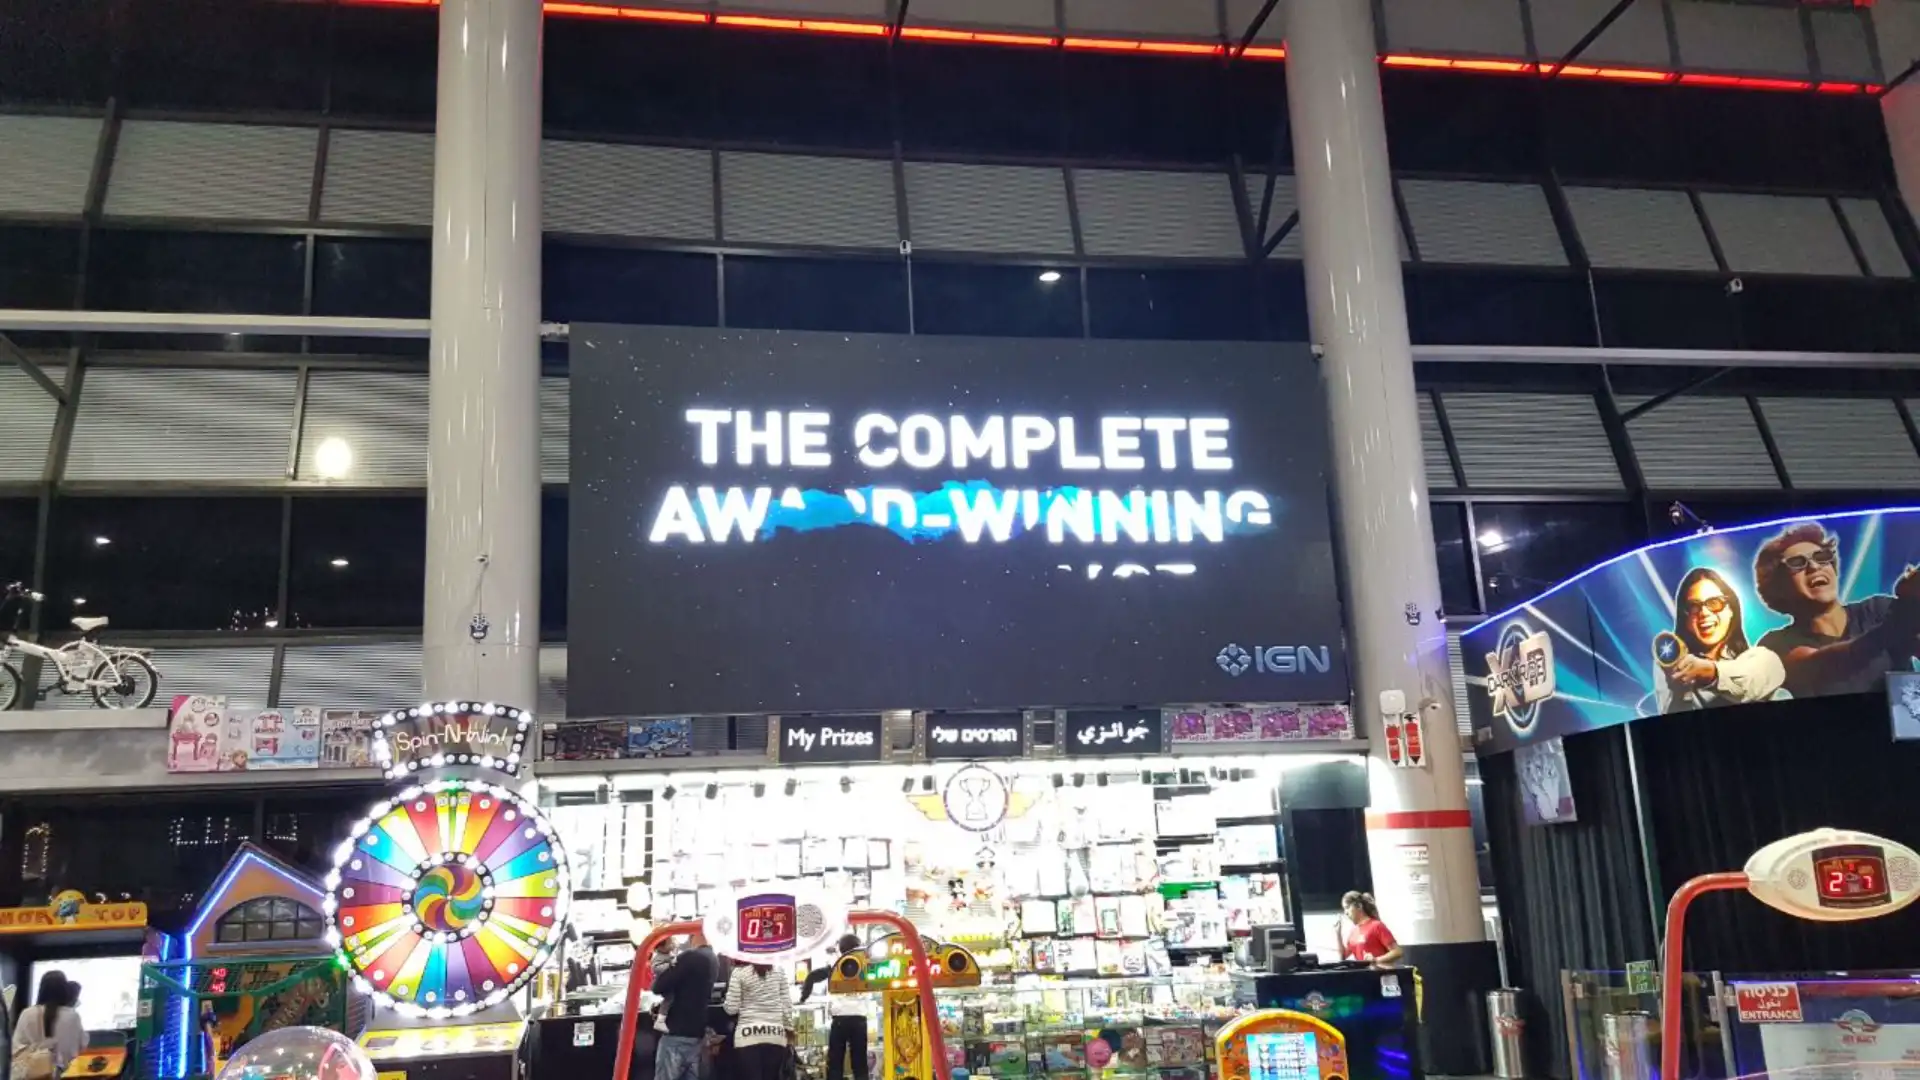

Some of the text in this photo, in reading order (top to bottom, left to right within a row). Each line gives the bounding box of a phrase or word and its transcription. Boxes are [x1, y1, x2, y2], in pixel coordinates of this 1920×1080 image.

[685, 409, 1234, 470] THE COMPLETE
[1254, 645, 1330, 673] IGN
[788, 727, 874, 751] My Prizes
[1829, 872, 1843, 892] 2
[747, 918, 760, 938] 0
[1741, 1010, 1801, 1020] ENTRANCE
